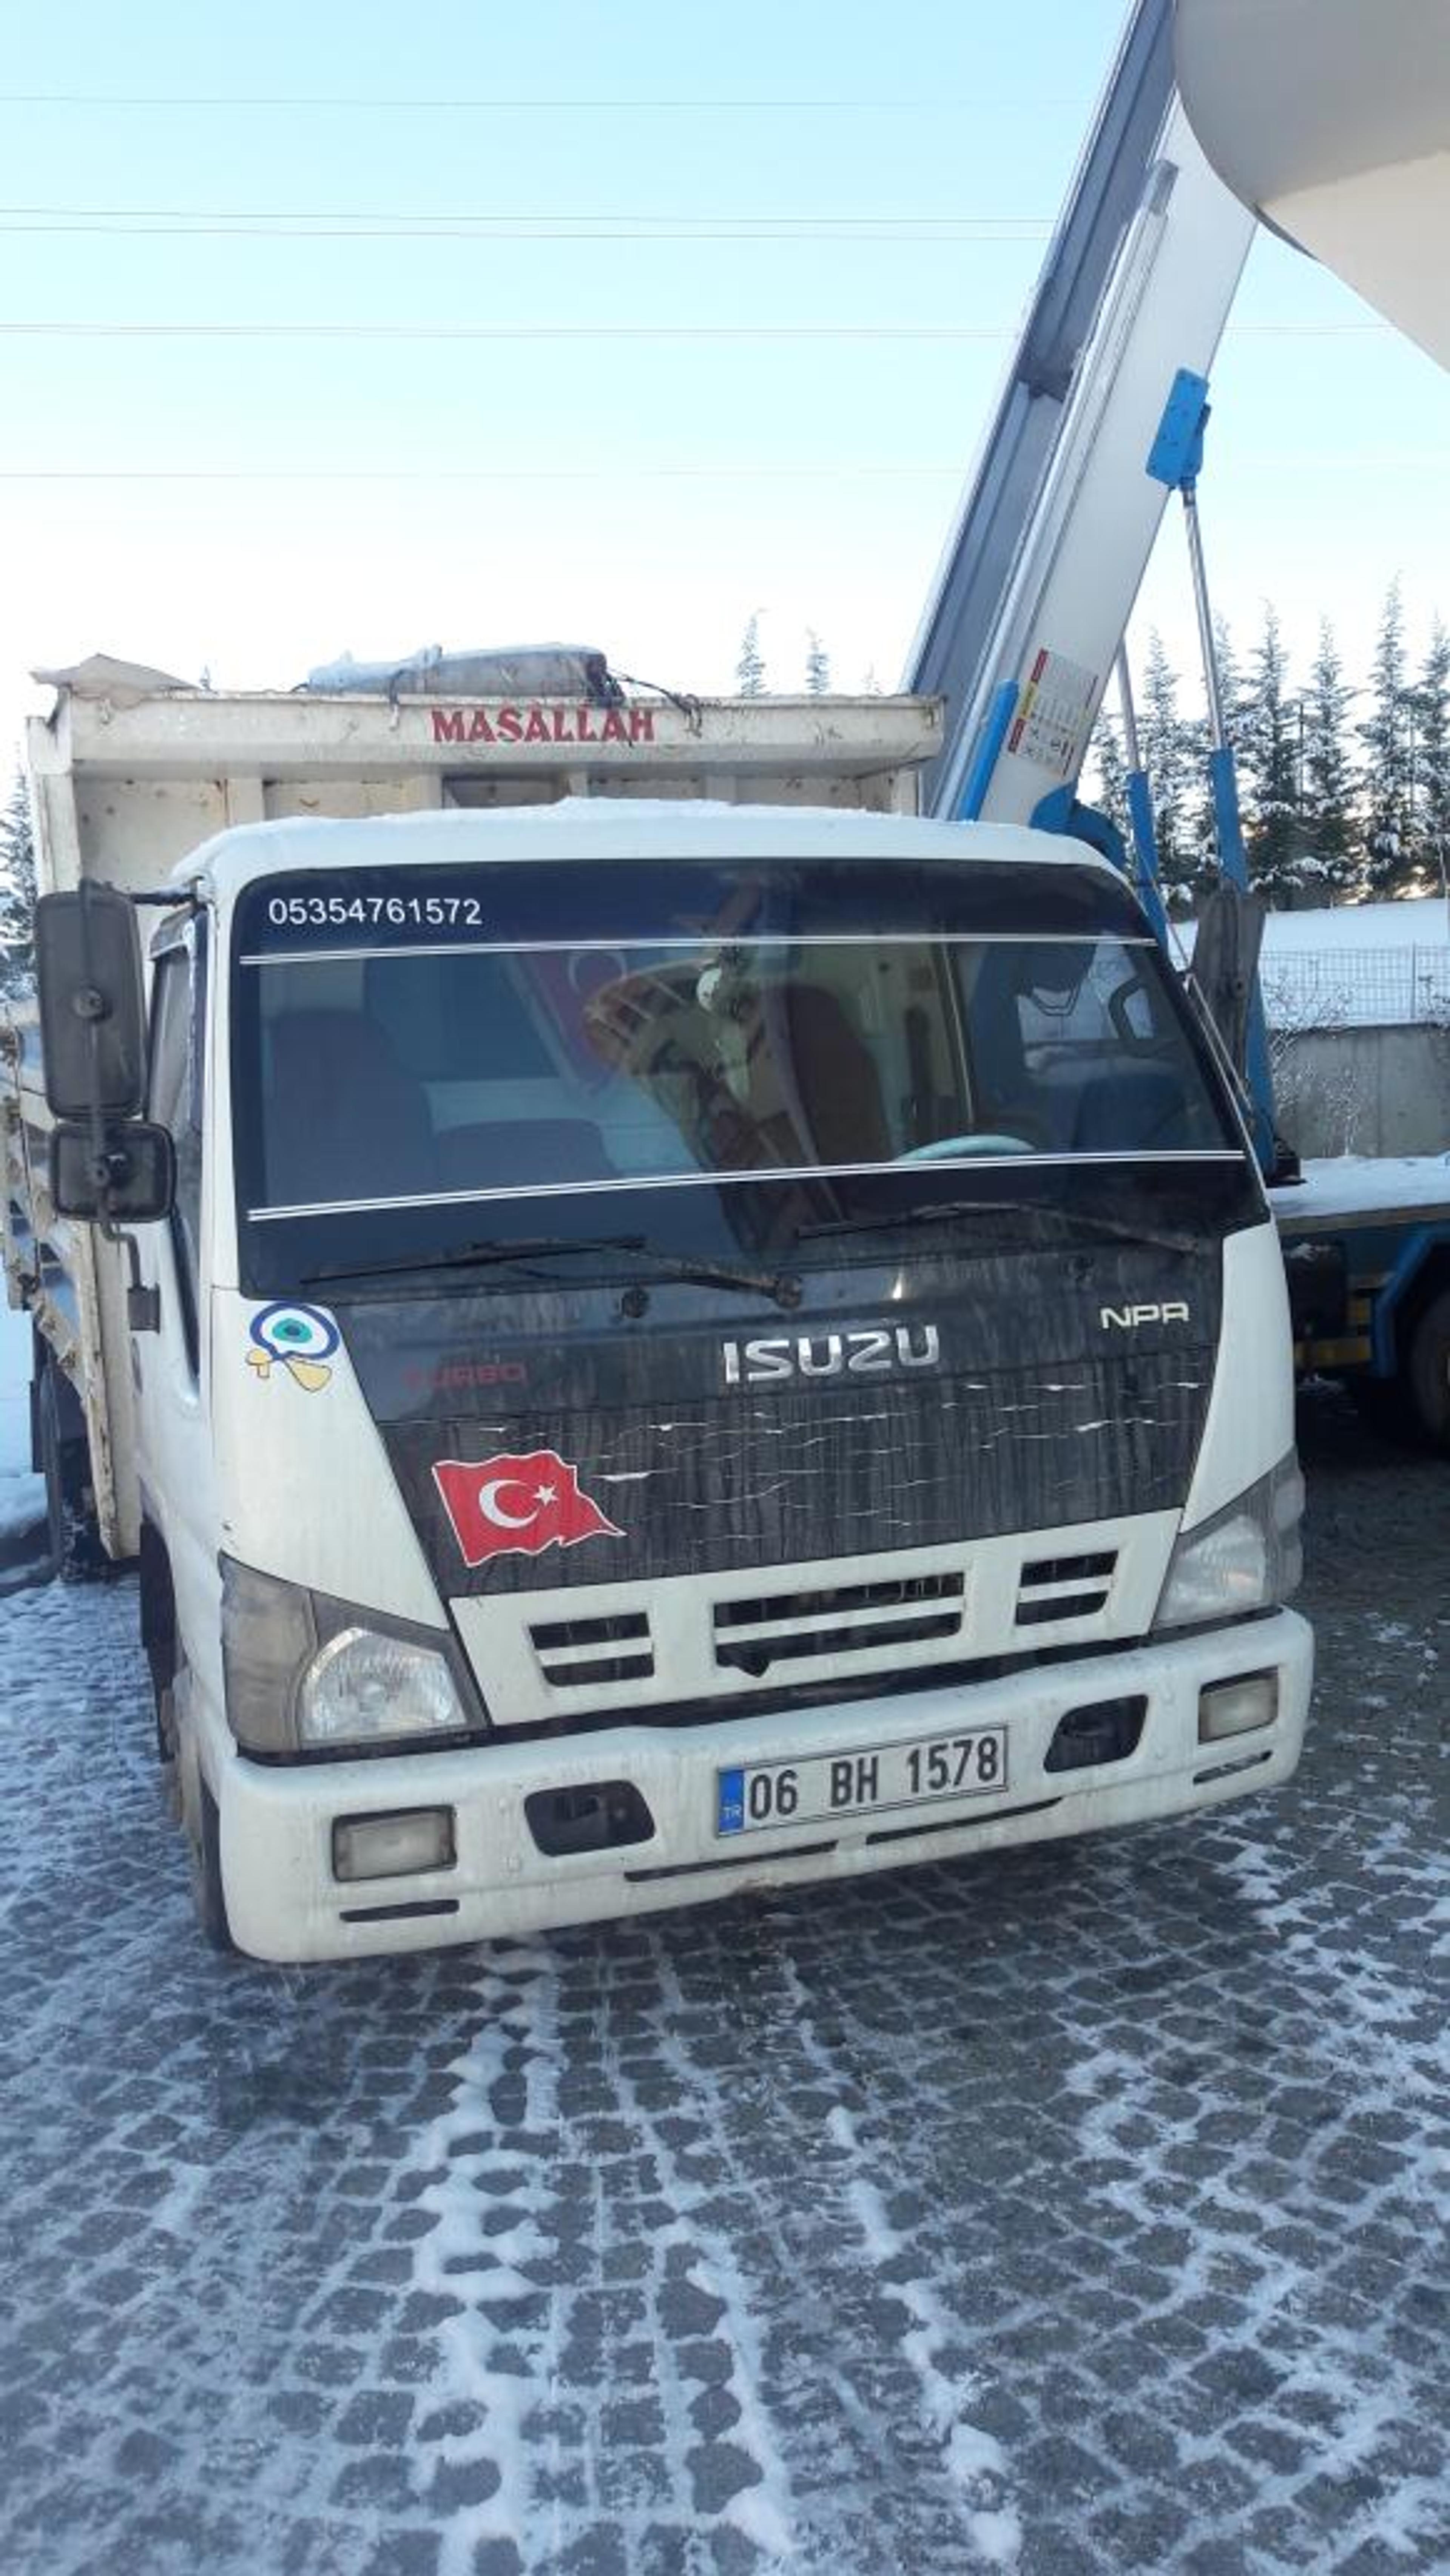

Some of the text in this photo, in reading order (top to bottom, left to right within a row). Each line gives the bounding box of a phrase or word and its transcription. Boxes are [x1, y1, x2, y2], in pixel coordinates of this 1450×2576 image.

[268, 898, 483, 925] 05354761572
[723, 1325, 939, 1383] ISUZU
[749, 1736, 998, 1820] 06 BH 1578
